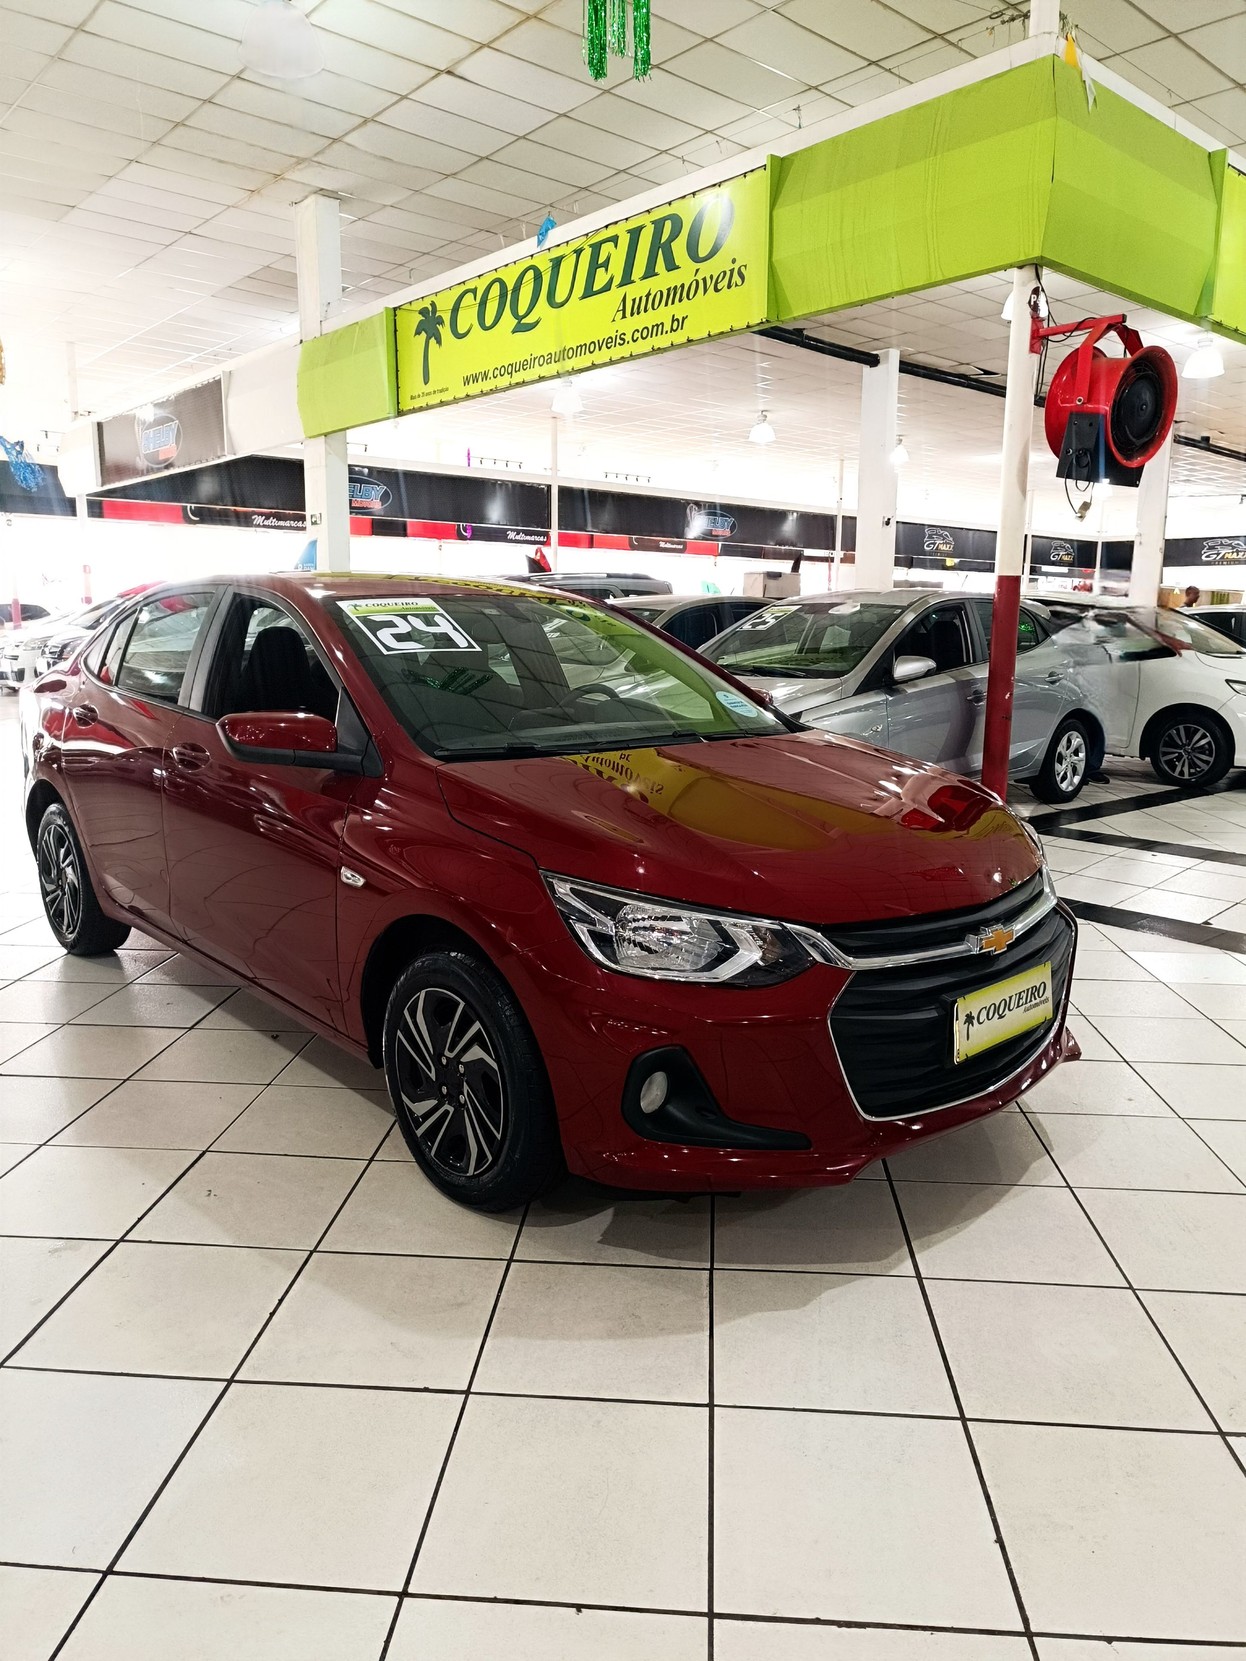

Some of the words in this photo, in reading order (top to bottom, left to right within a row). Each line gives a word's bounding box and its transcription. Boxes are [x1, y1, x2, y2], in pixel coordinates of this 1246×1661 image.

[449, 194, 735, 340] COQUEIRO
[611, 257, 748, 323] Automóveis
[462, 313, 689, 387] www.coqueiroautomoveis.com.br
[348, 483, 387, 502] ELBY
[506, 530, 548, 542] Multimarcas
[924, 540, 944, 551] GT
[1050, 552, 1066, 561] GT
[1201, 550, 1233, 560] GT
[741, 613, 788, 629] 25
[366, 614, 469, 650] 24
[976, 981, 1047, 1025] COQUEIRO
[1022, 996, 1050, 1014] Automóveis
